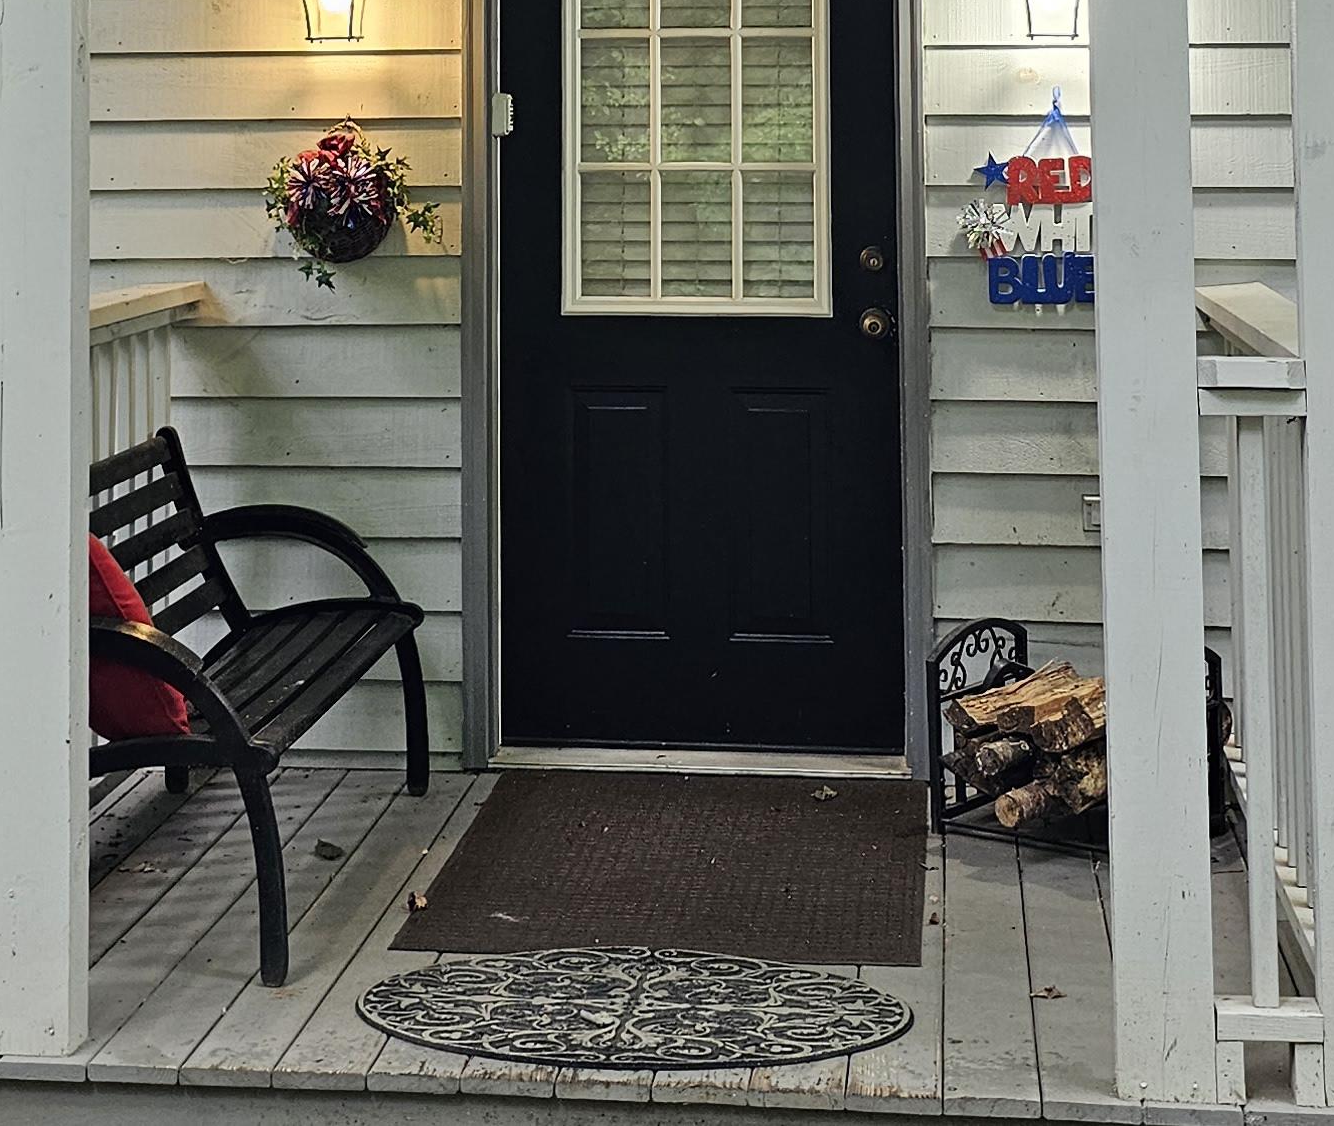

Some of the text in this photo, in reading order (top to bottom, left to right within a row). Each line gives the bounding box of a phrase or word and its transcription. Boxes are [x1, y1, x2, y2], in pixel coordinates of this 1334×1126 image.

[1006, 155, 1092, 206] RED
[992, 202, 1093, 252] WHI
[988, 251, 1095, 304] BLUE
